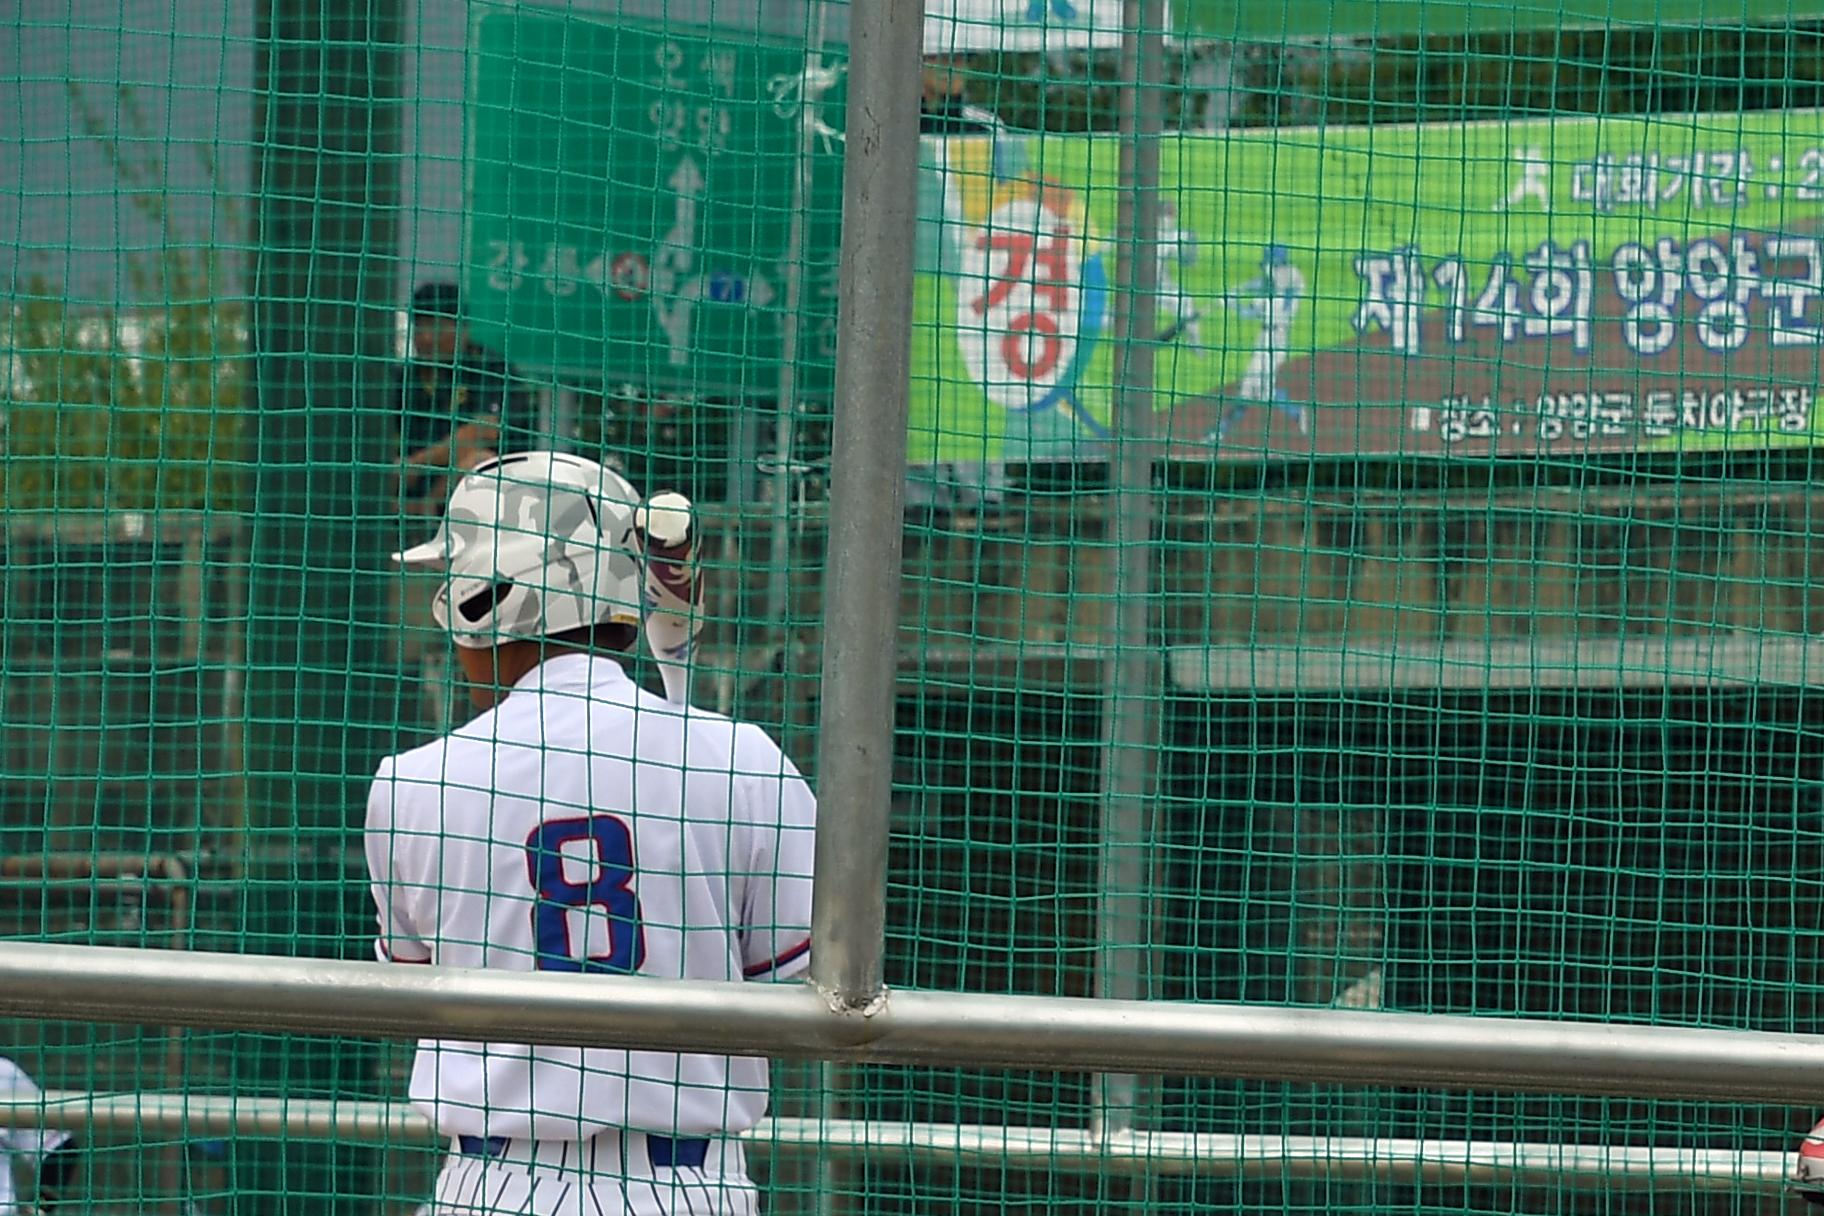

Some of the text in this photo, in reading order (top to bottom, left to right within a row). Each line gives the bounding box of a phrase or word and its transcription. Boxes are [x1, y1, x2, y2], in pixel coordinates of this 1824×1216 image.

[1572, 148, 1754, 212] 대회기간
[971, 224, 1070, 381] 경
[1350, 240, 1594, 357] 제14회
[1643, 386, 1813, 436] 둔치야구장
[524, 813, 648, 974] 8
